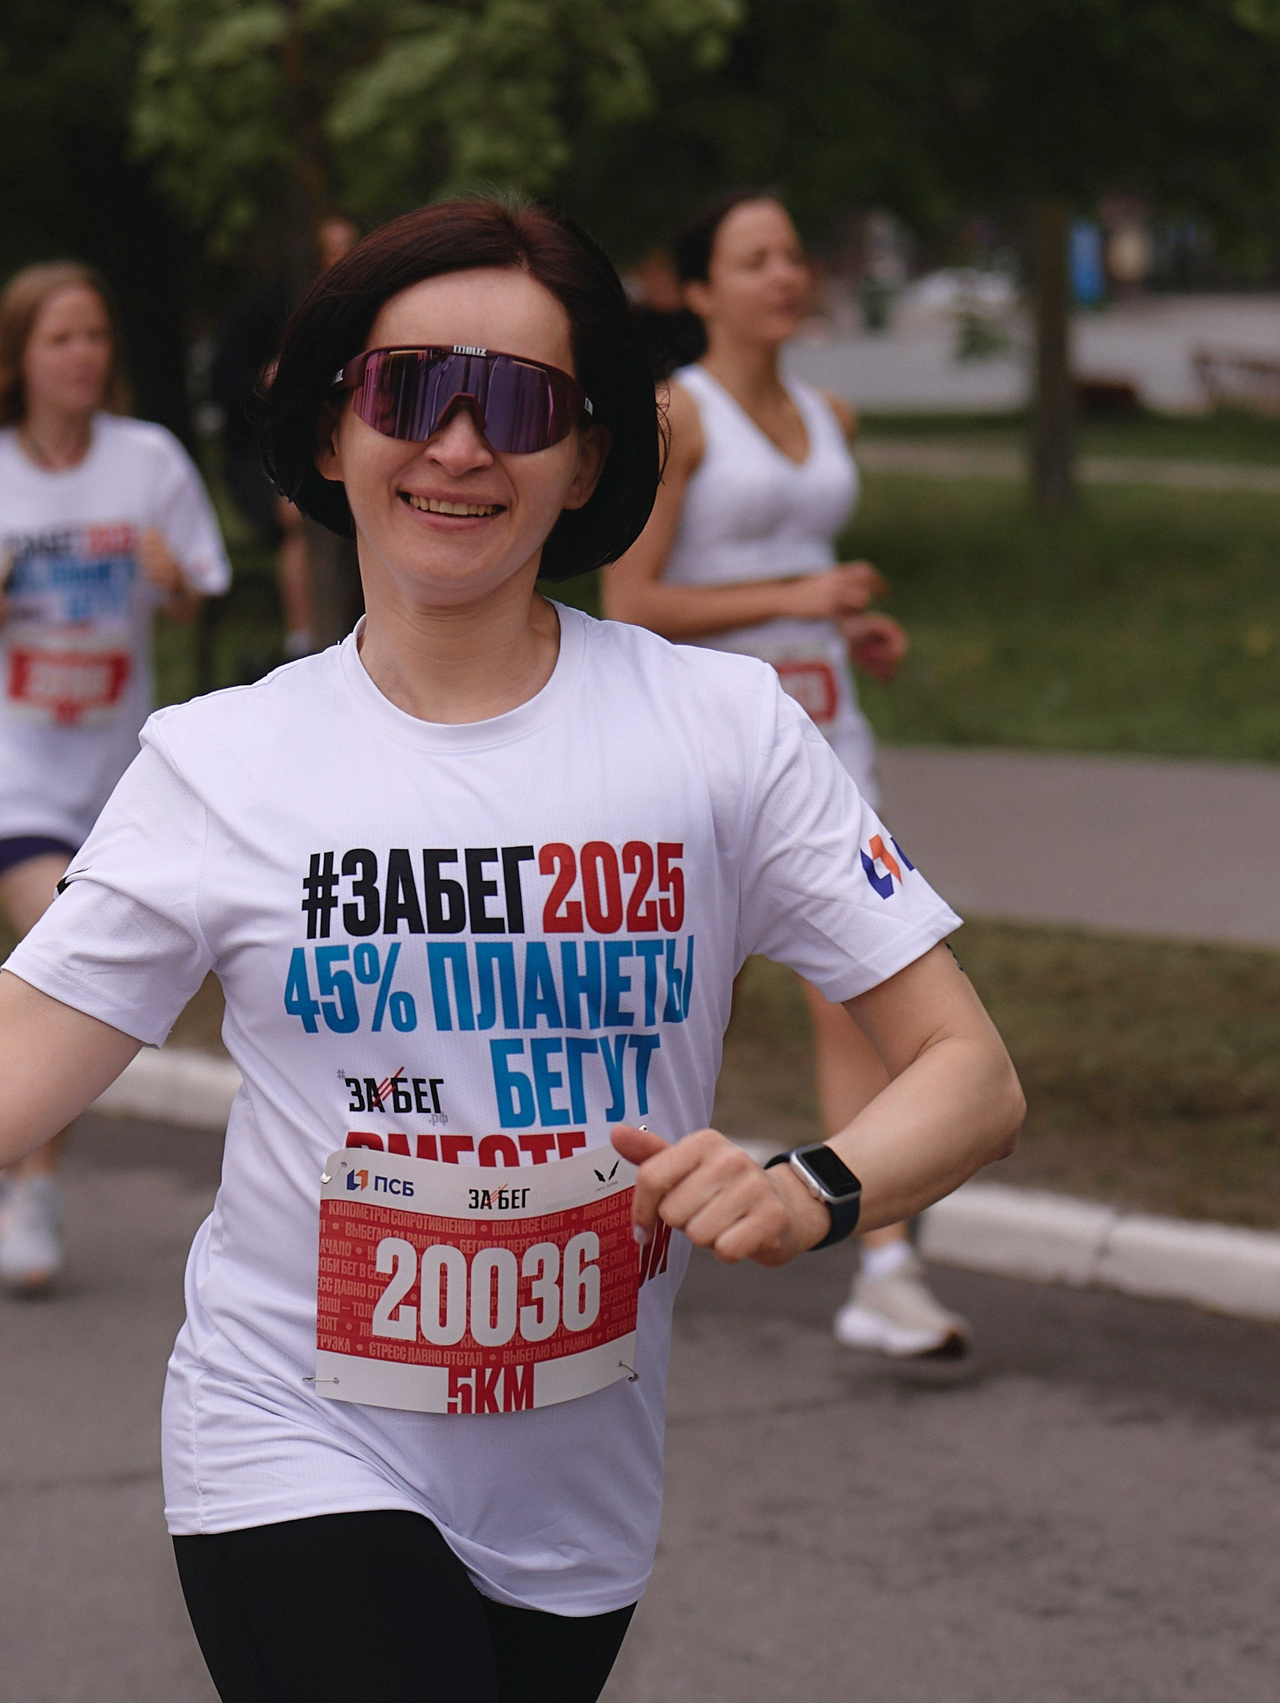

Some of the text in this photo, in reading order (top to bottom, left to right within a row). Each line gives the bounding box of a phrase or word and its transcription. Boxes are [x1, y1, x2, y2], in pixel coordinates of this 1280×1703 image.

[284, 935, 694, 1034] 45% ПЛАНЕТЫ
[489, 1033, 660, 1128] БЕГУТ
[374, 1176, 415, 1197] ПСБ
[328, 1201, 390, 1224] КИЛОМЕТРЫ
[492, 1221, 520, 1236] ПОКА
[521, 1218, 540, 1234] ВСЕ
[341, 1259, 358, 1276] БЕГ
[359, 1262, 366, 1278] В
[333, 1279, 367, 1298] ДАВНО
[372, 1231, 601, 1347] 20036
[369, 1341, 406, 1360] СТРЕСС
[407, 1347, 442, 1364] ДАВНО
[443, 1351, 483, 1366] ОТСТАЛ
[502, 1343, 550, 1365] ВЫБЕГАЮ
[551, 1341, 563, 1357] ЗА
[563, 1332, 593, 1354] РАМКИ
